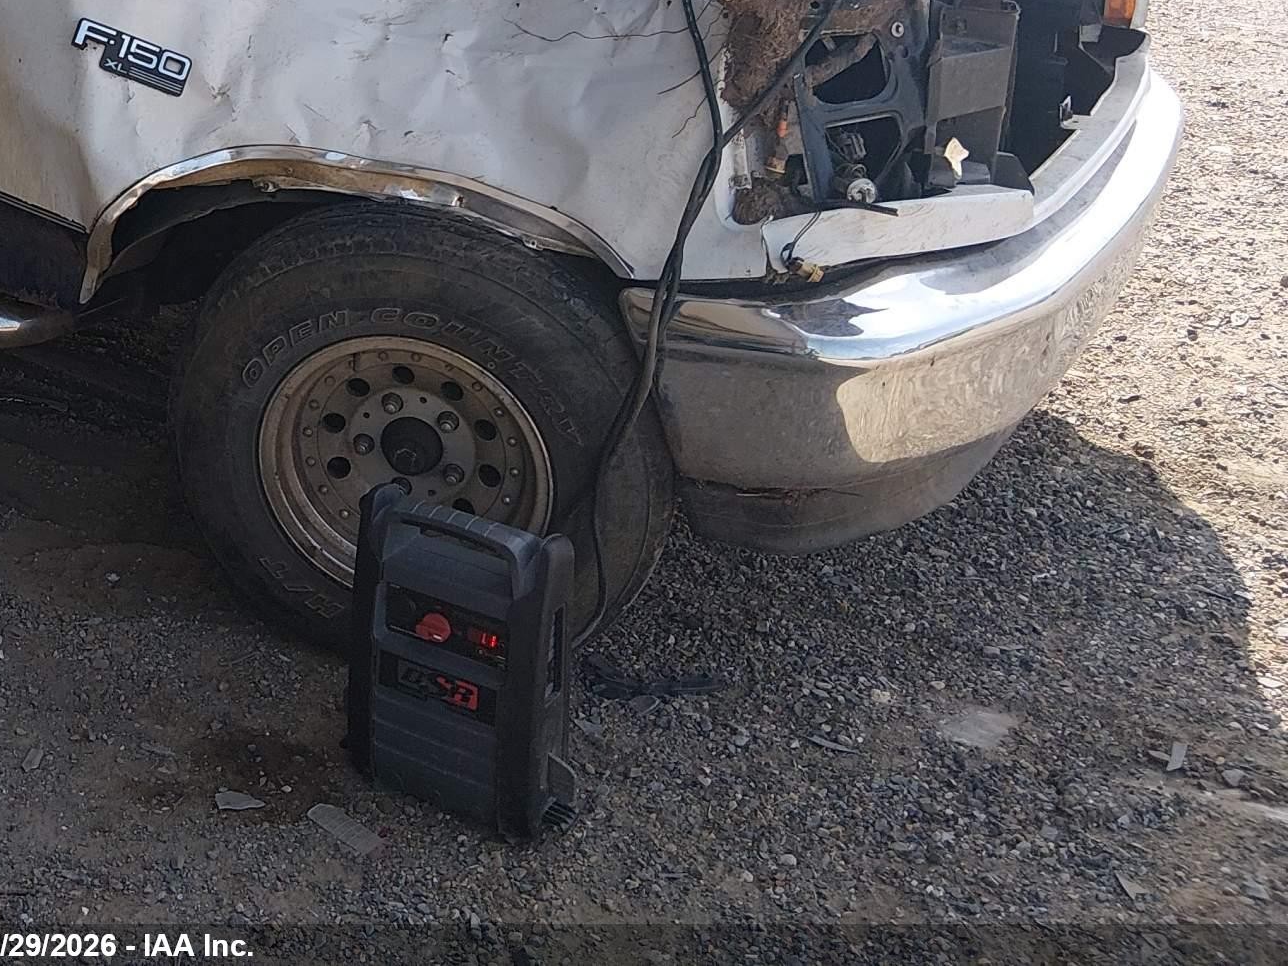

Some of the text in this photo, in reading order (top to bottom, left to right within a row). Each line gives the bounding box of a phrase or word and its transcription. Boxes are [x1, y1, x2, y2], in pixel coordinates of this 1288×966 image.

[104, 58, 128, 75] XL
[240, 307, 585, 448] OPEN COUNTRY
